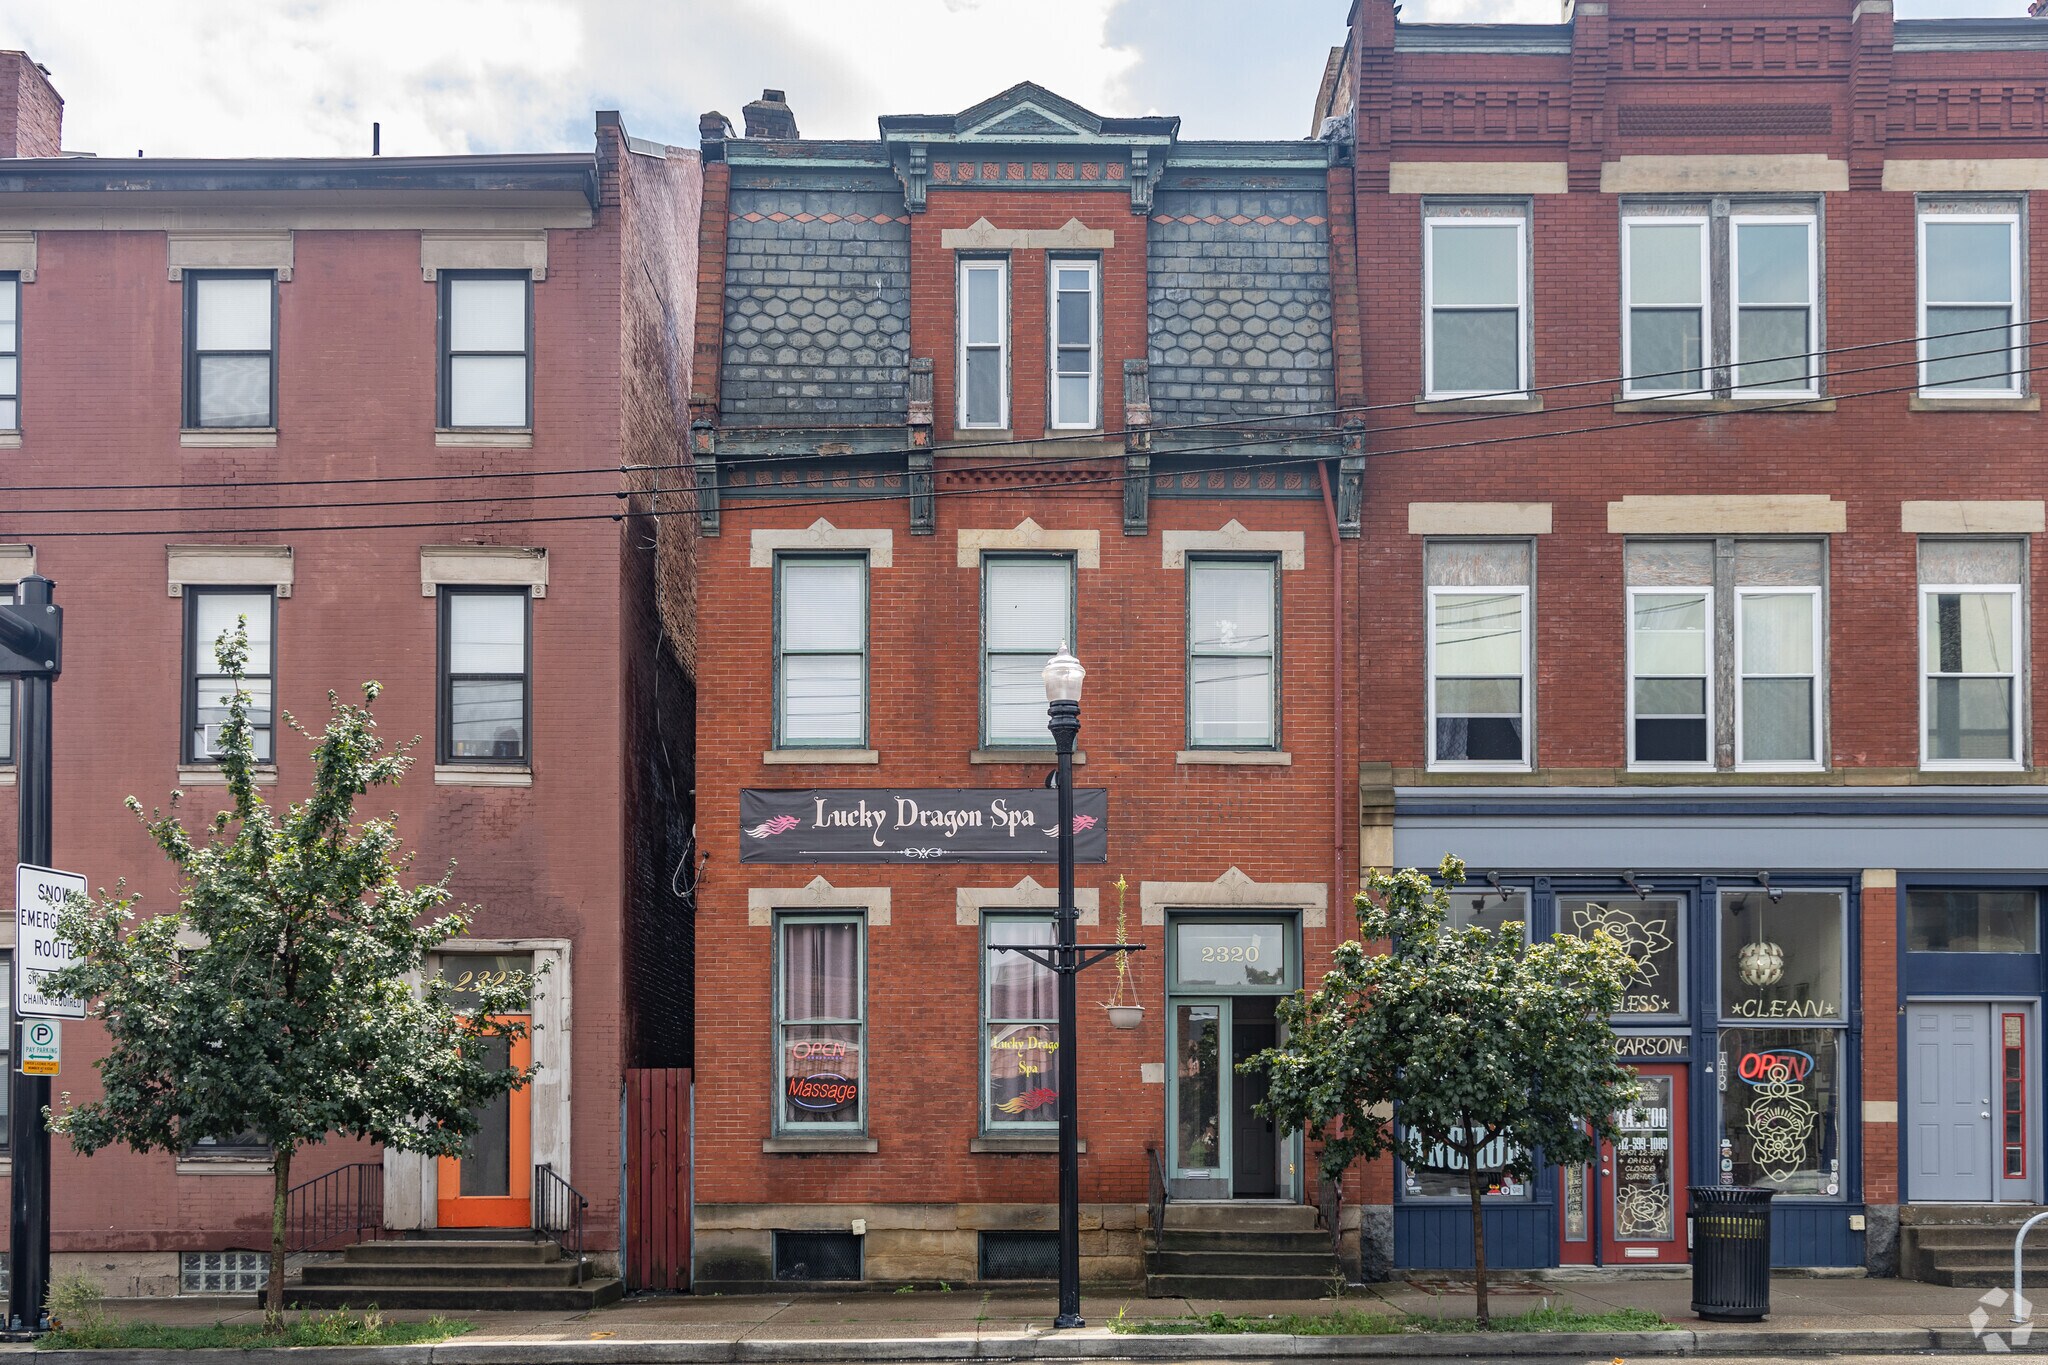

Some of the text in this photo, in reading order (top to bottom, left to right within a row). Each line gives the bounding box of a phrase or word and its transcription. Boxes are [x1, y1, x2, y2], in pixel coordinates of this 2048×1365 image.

[812, 796, 1036, 847] Lucky Dragon Spa
[34, 939, 73, 960] ROUTE
[1201, 946, 1259, 962] 2320
[23, 993, 49, 1006] CHAINS
[1742, 999, 1824, 1017] CLEAN
[793, 1042, 846, 1059] OPEN
[992, 1036, 1059, 1057] Lucky Drago
[1019, 1061, 1038, 1077] Spa
[1740, 1053, 1807, 1082] OPEN
[789, 1078, 857, 1103] Massage
[1624, 1165, 1656, 1173] CLOSED
